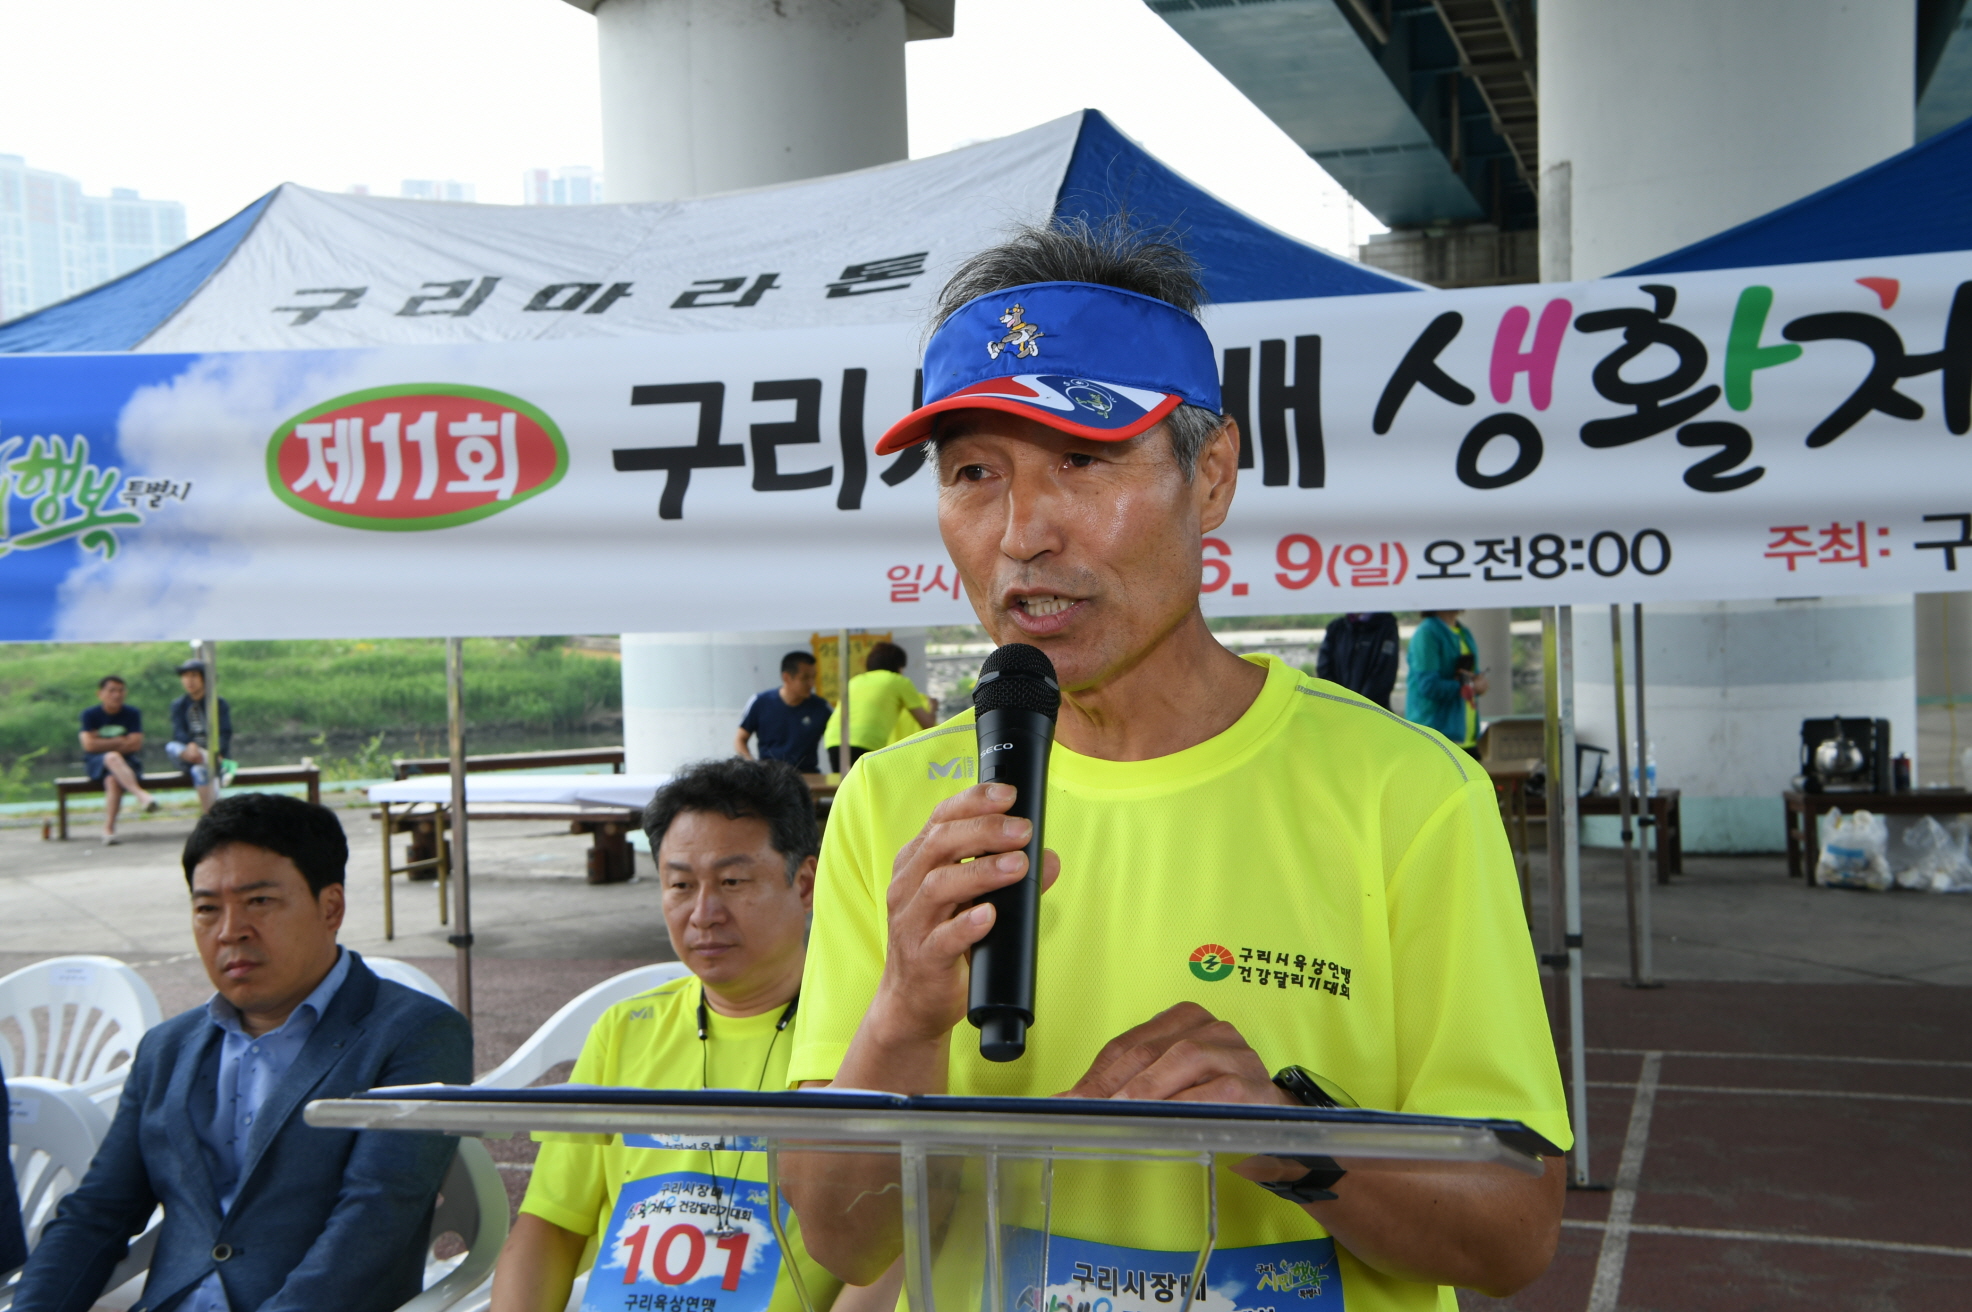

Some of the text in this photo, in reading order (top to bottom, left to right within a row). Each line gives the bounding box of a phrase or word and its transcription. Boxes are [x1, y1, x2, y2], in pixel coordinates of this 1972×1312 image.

[292, 410, 518, 505] 제11회
[1764, 520, 1891, 571] 주최:
[622, 1223, 750, 1292] 101
